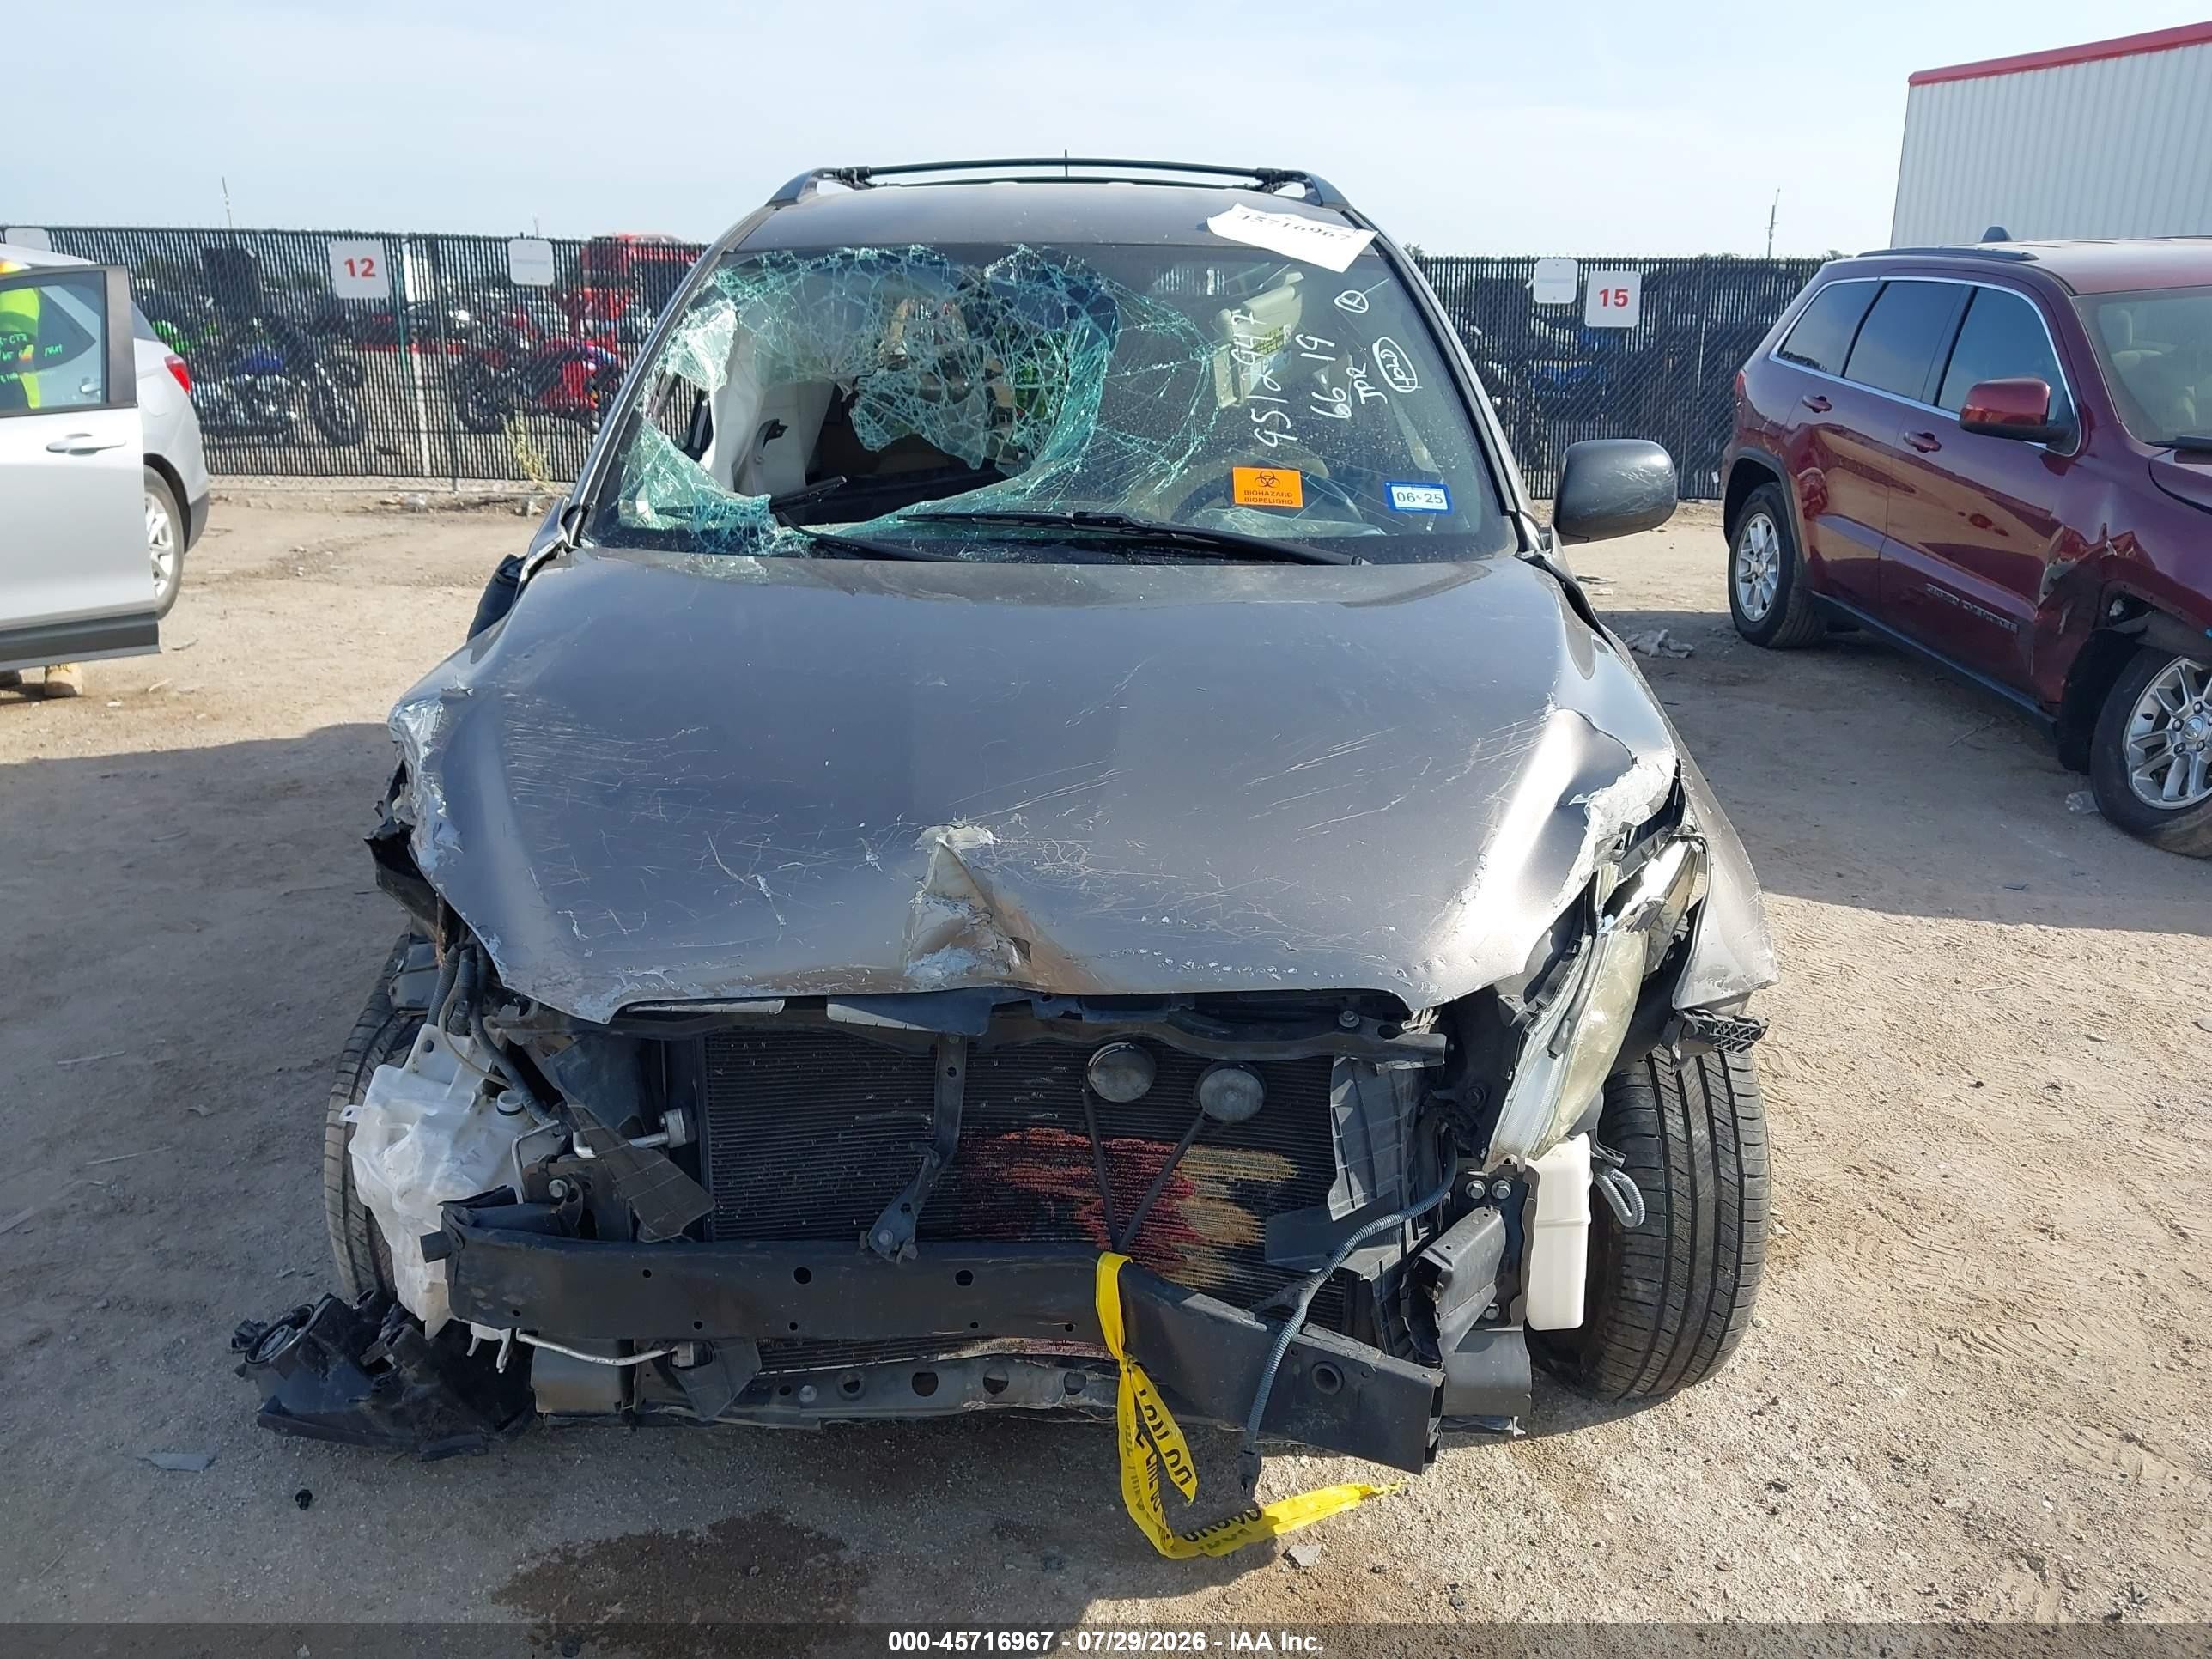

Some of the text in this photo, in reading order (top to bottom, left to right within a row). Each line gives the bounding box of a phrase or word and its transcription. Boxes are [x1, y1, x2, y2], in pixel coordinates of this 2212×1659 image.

[344, 258, 376, 277] 12
[1599, 289, 1628, 307] 15
[1243, 489, 1293, 498] BIOHAZARD
